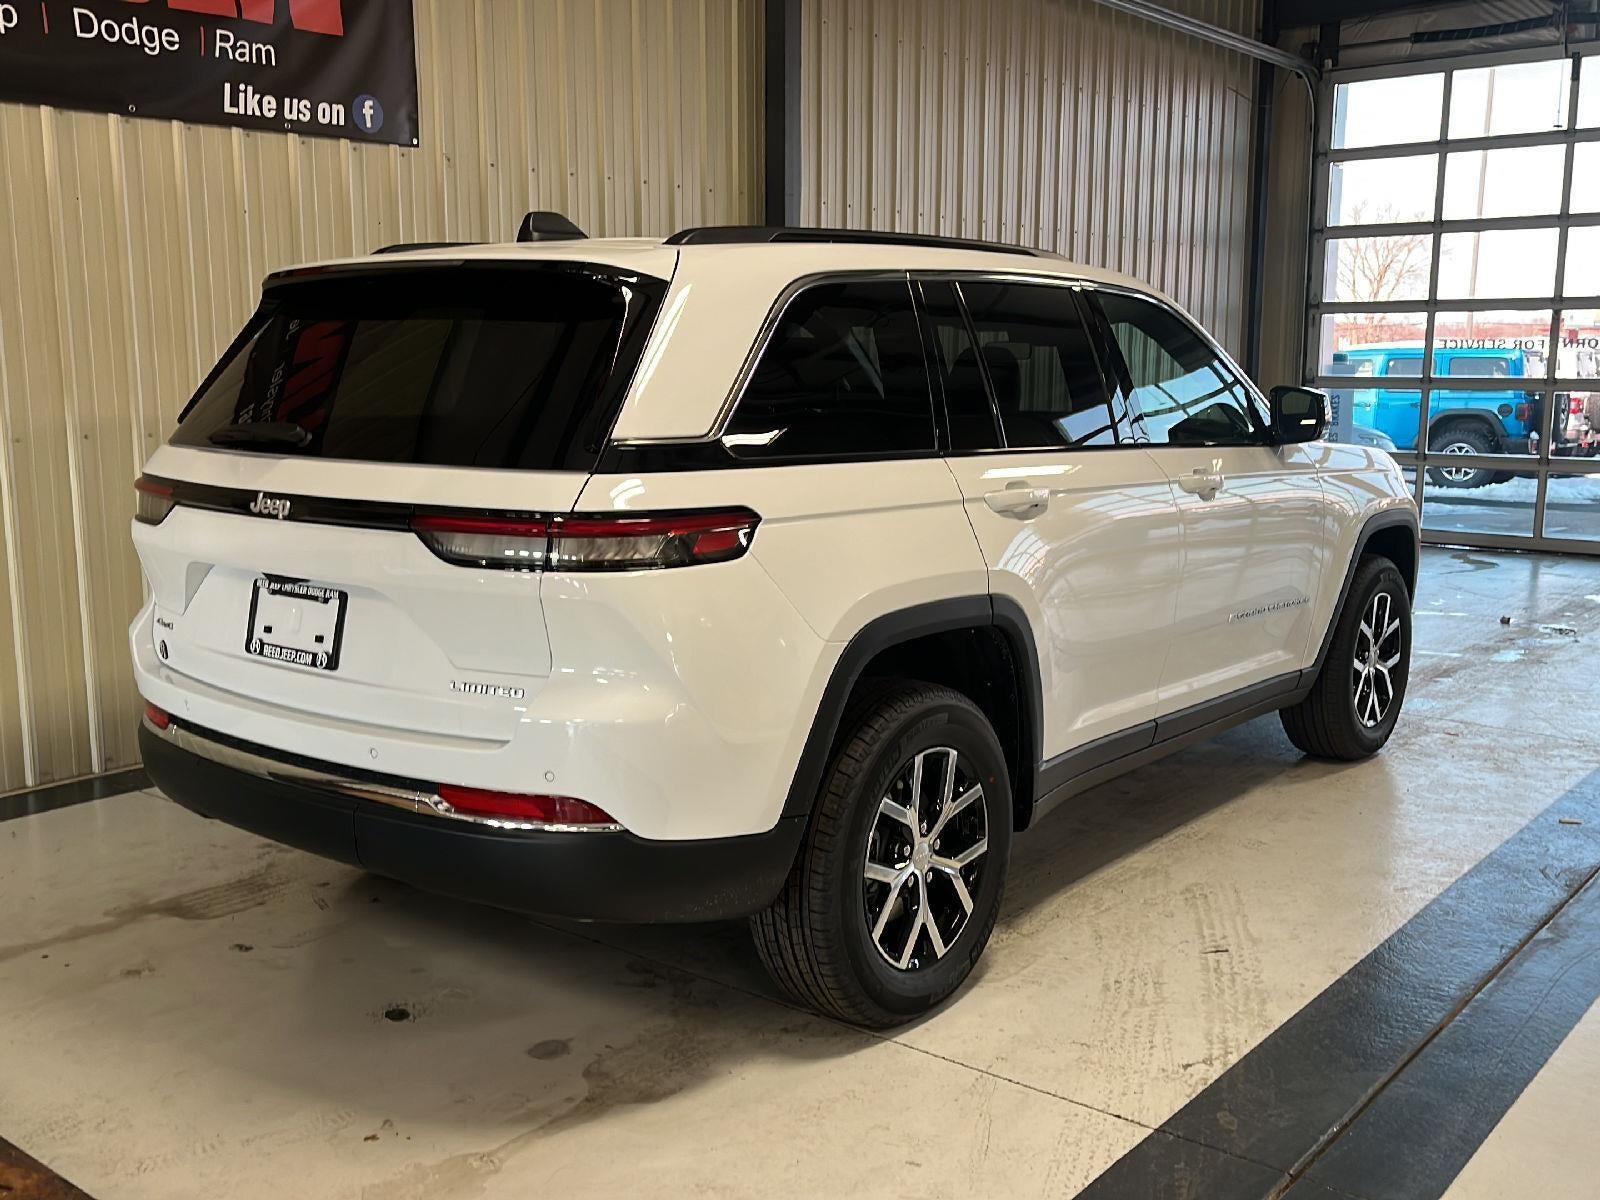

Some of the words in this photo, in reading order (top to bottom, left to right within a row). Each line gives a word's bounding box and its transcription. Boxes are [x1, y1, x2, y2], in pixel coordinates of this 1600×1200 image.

[73, 7, 181, 56] Dodge
[214, 29, 277, 67] Ram
[223, 82, 277, 118] Like
[283, 94, 311, 123] us
[317, 100, 345, 126] on
[250, 492, 291, 519] Jeep
[325, 589, 339, 600] RAM
[263, 643, 313, 666] REEDJEEP.COM
[449, 679, 525, 699] LIMITED
